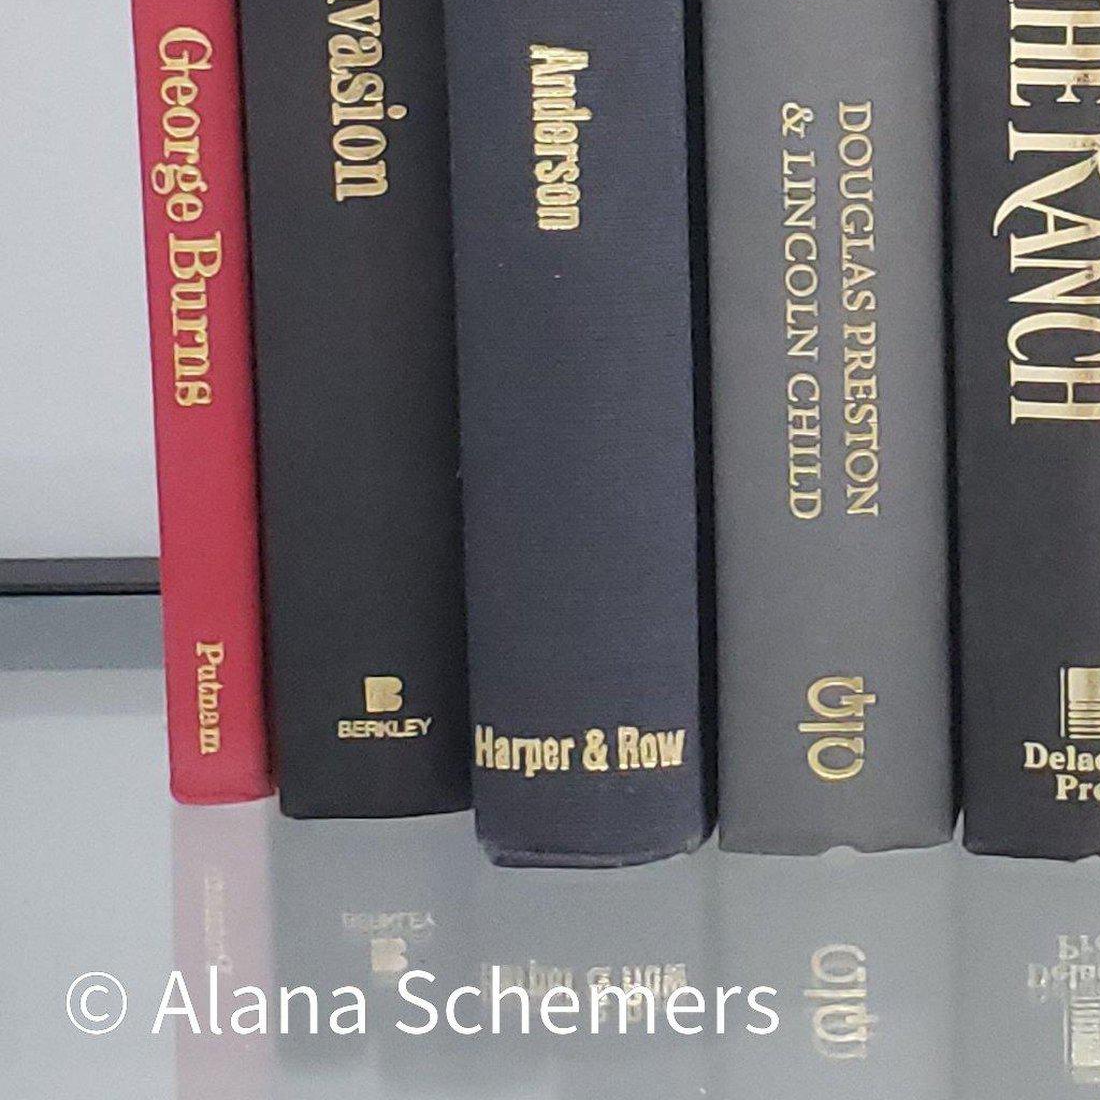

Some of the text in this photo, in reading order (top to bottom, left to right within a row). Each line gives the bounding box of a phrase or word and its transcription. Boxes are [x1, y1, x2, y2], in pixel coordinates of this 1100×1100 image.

[150, 26, 222, 407] George Burns
[529, 44, 592, 231] Anderson
[781, 102, 822, 520] & LINCOLN CHILD
[838, 101, 880, 517] DOUGLAS PRESTON
[195, 642, 224, 755] Putnam
[337, 717, 432, 739] BERKLEY
[475, 724, 686, 778] Harper & Row
